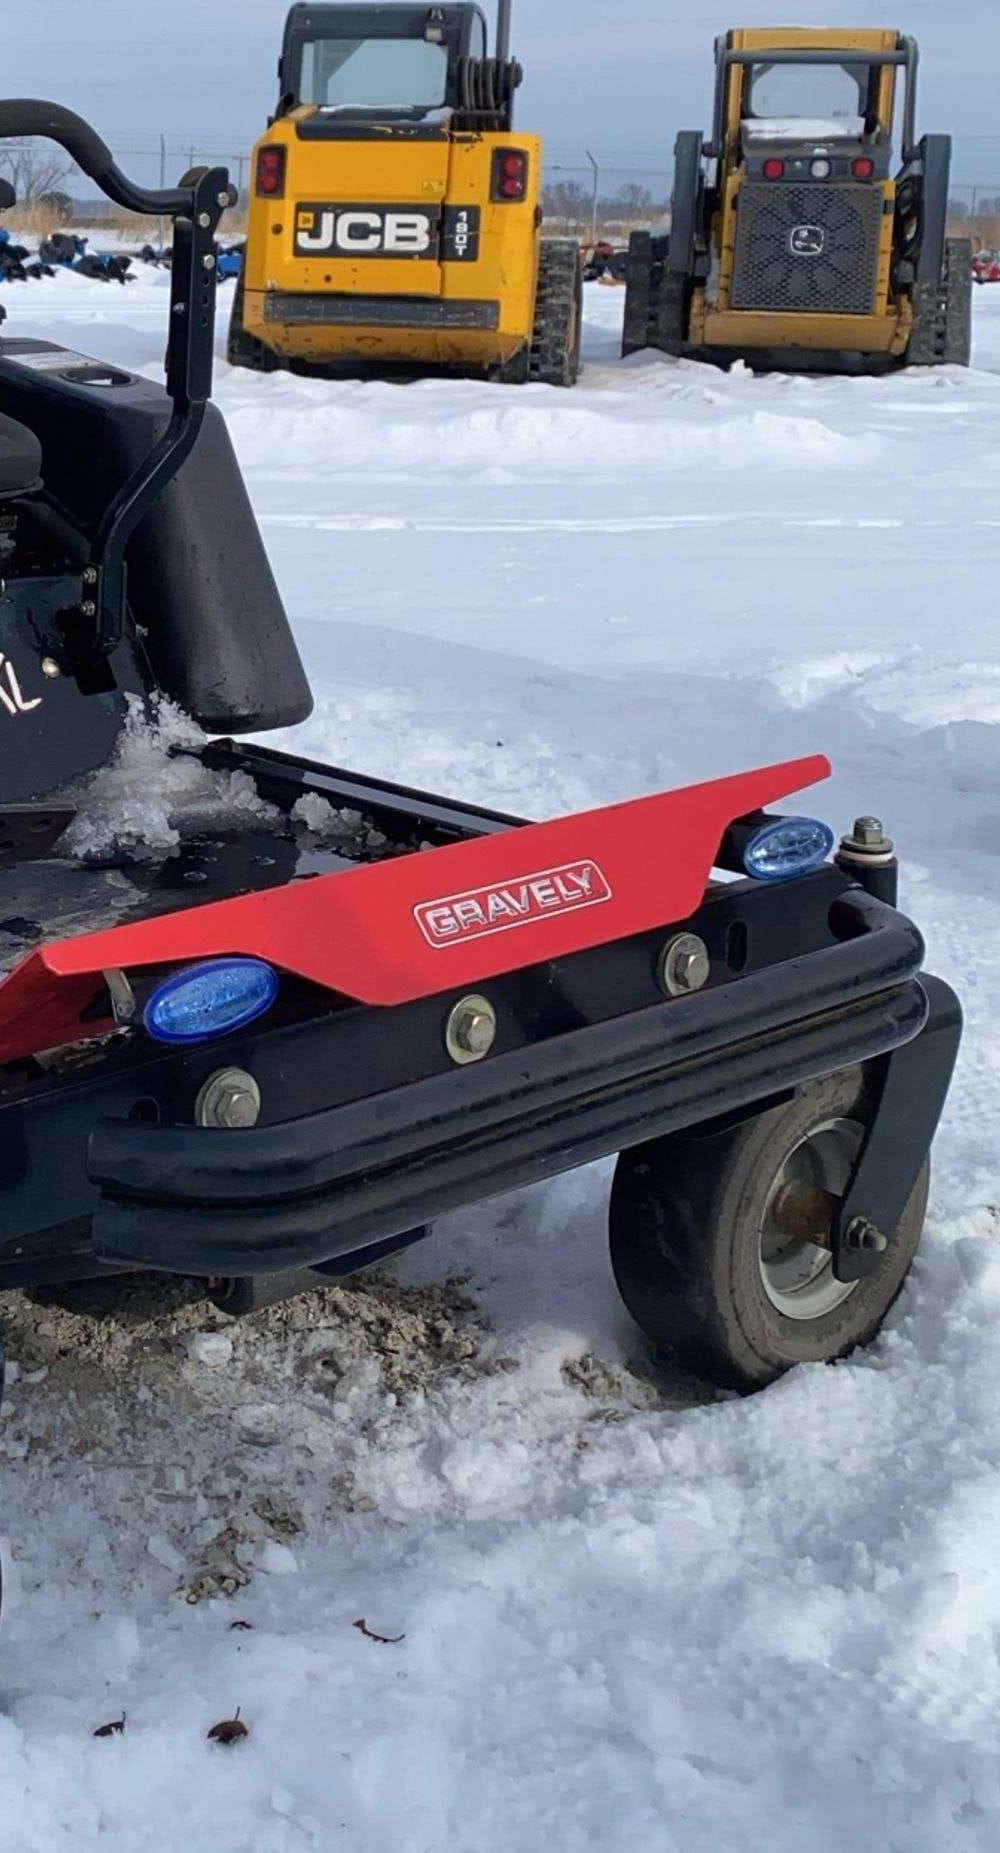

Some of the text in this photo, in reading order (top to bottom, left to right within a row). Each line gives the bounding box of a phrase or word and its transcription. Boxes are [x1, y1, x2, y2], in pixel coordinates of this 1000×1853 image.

[297, 212, 430, 251] JCB
[454, 211, 468, 256] 190T
[425, 867, 592, 937] GRAVELY
